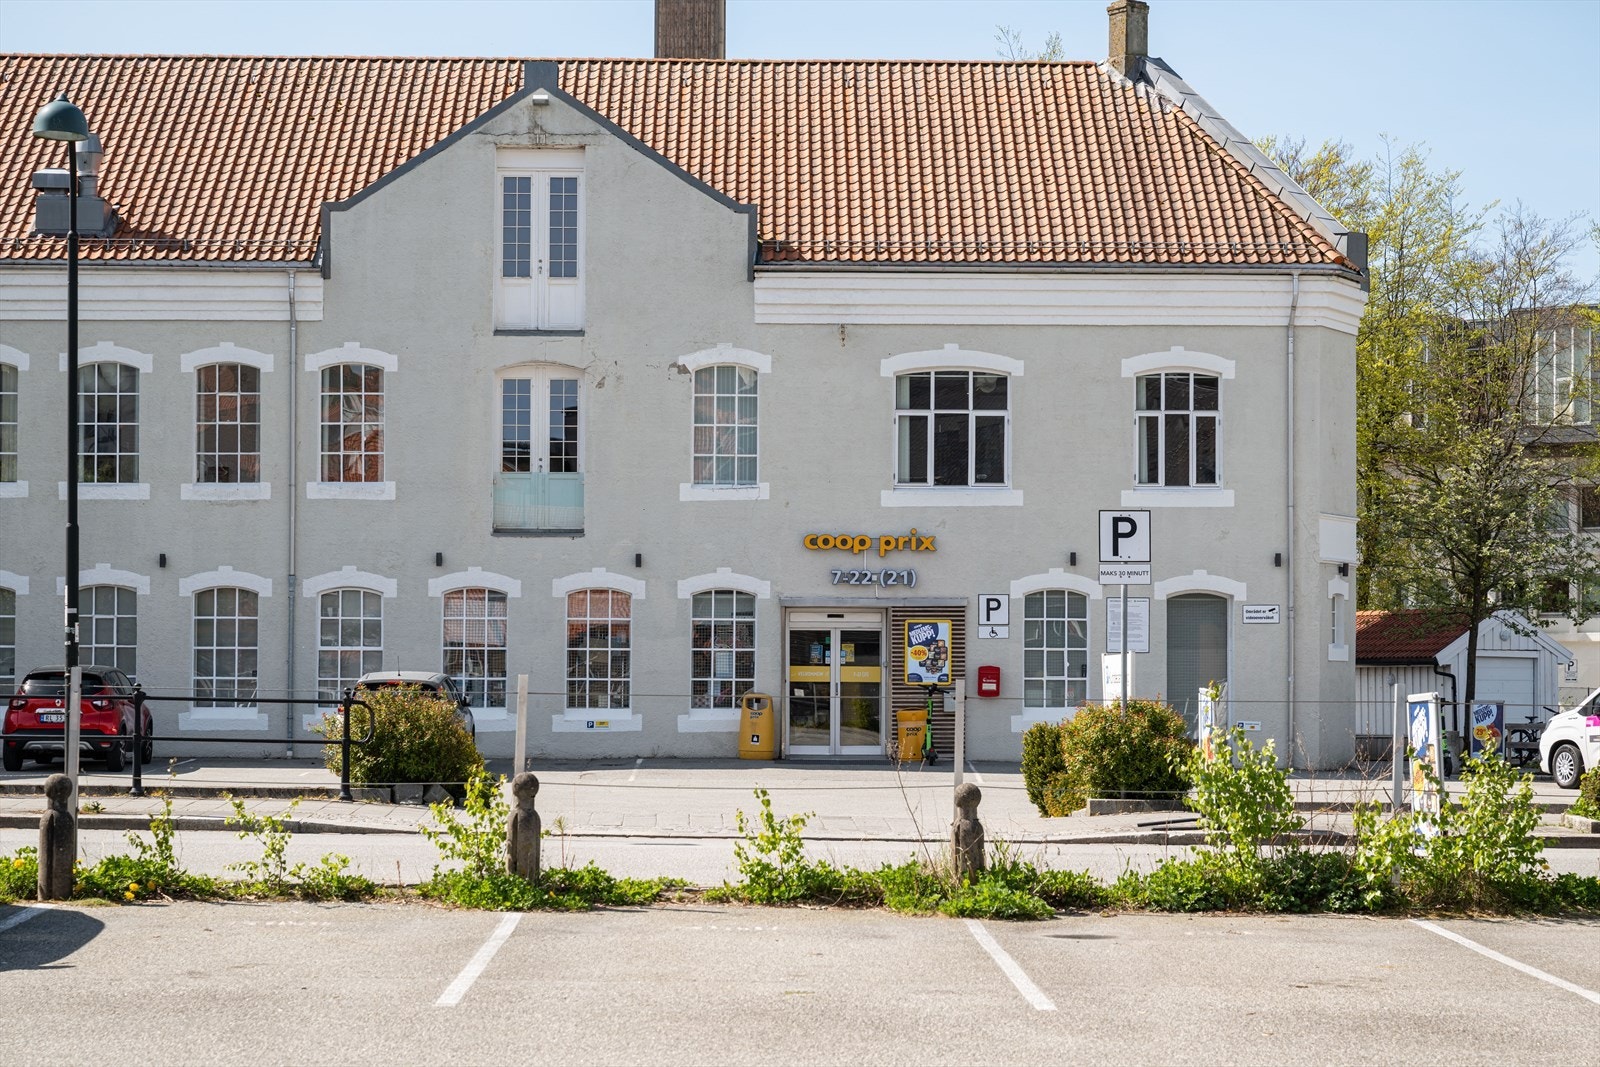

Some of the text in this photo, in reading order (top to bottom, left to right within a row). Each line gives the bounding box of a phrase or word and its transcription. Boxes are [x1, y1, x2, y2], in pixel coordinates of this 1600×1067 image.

[804, 528, 937, 558] coop prix
[1112, 516, 1138, 557] P
[830, 568, 917, 588] 7-22 (21)
[986, 597, 1002, 622] P
[910, 629, 936, 645] KUPP!
[911, 649, 927, 657] -40%
[1567, 660, 1575, 671] P
[1475, 709, 1495, 725] KUPP!
